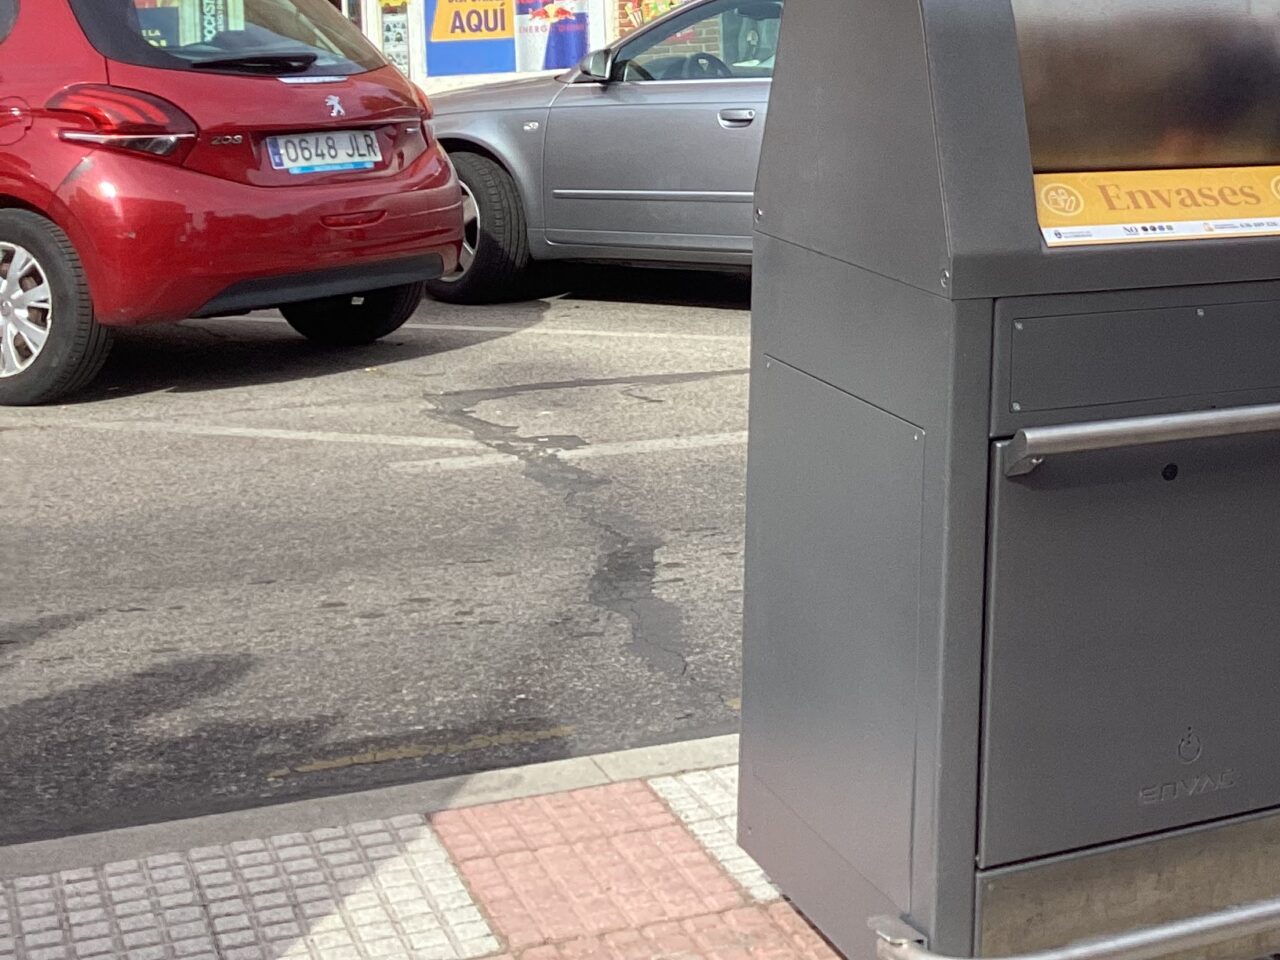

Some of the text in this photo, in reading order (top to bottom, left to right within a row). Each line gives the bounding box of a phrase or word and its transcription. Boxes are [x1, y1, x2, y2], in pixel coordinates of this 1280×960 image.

[450, 3, 506, 35] AQUÍ
[285, 133, 378, 163] 0648 JLR
[1096, 181, 1262, 211] Envases
